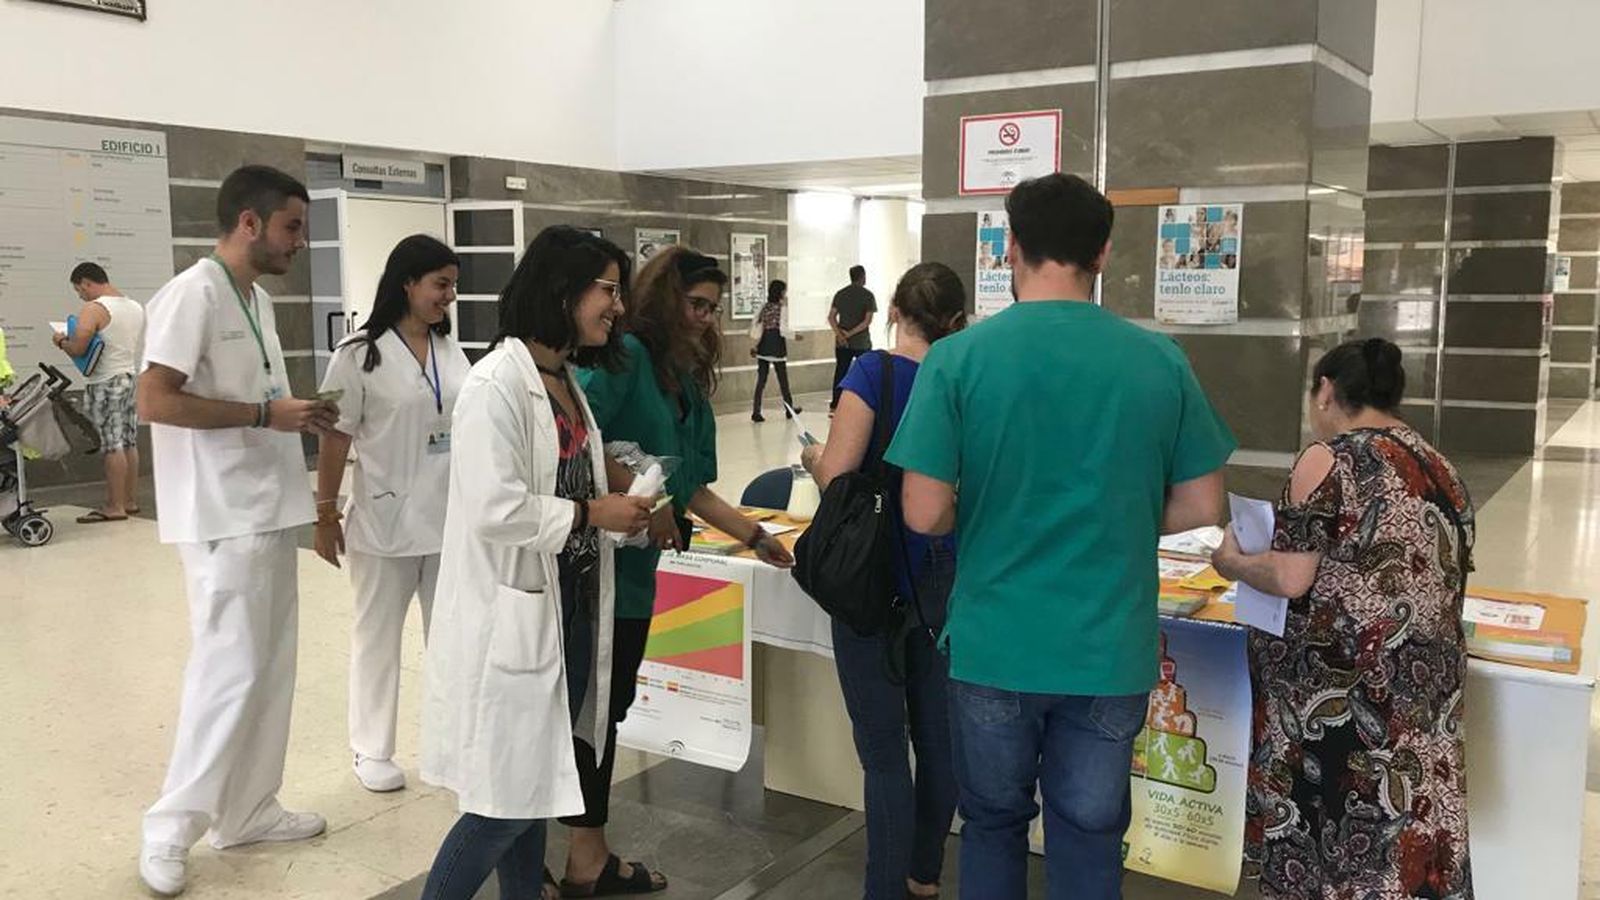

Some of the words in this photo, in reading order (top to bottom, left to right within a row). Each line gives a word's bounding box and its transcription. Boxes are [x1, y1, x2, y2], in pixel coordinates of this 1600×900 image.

[101, 139, 153, 154] EDIFICIO
[1160, 270, 1212, 282] Lácteos:
[979, 282, 1006, 293] tenlo
[1160, 283, 1192, 295] tenlo
[1194, 283, 1226, 295] claro
[1148, 789, 1175, 805] VIDA
[1180, 797, 1223, 816] ACTIVA
